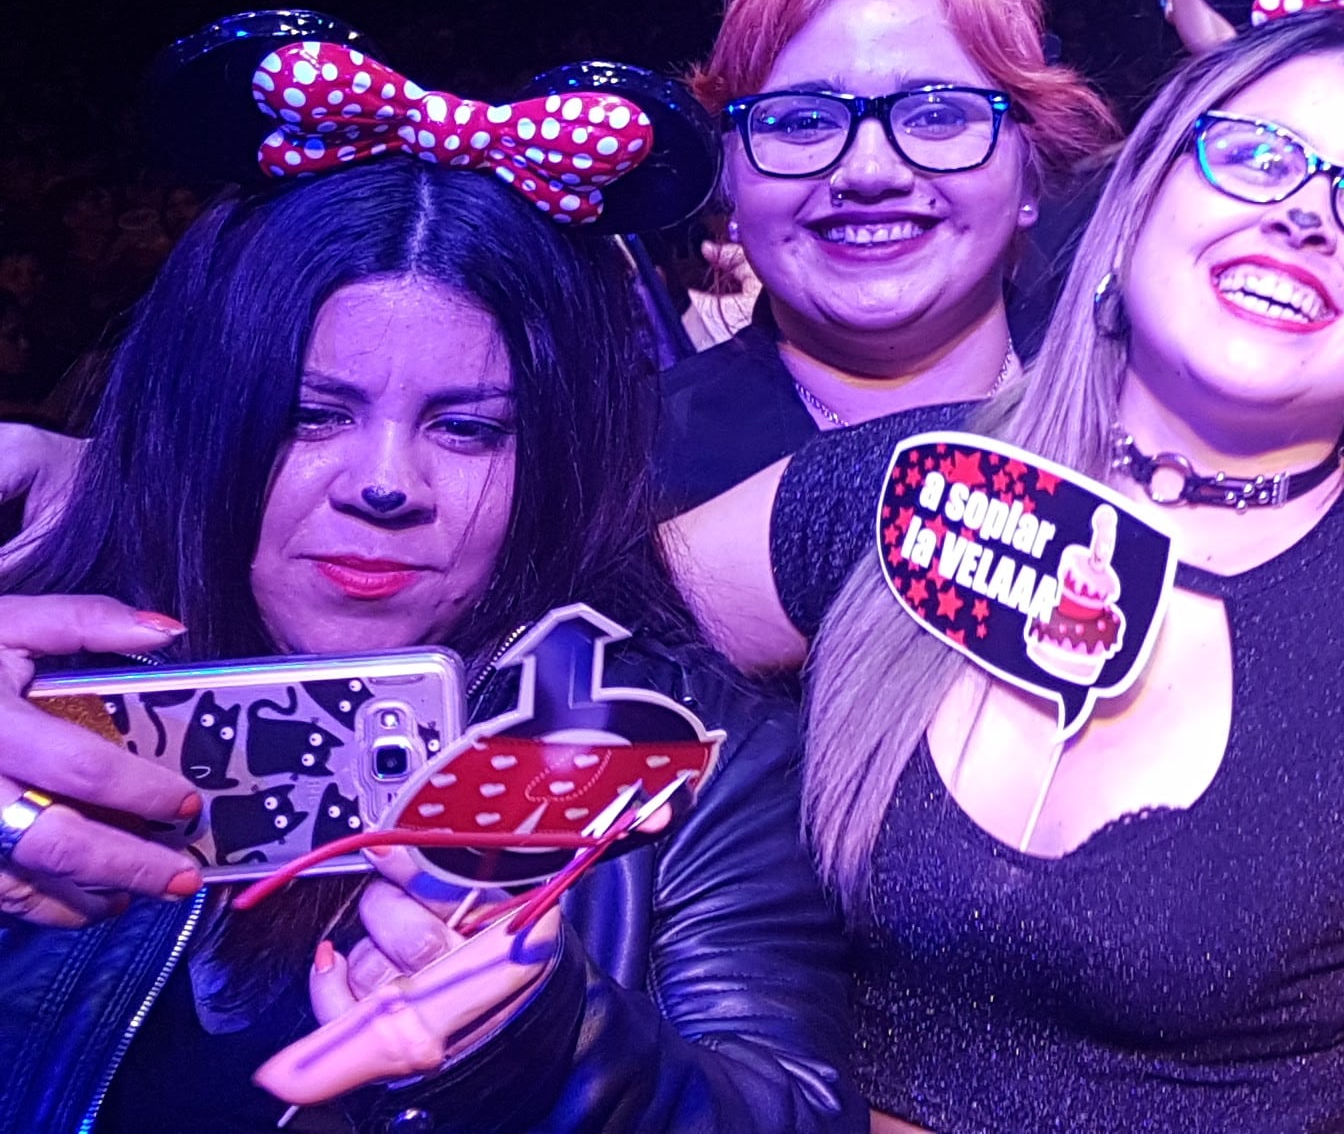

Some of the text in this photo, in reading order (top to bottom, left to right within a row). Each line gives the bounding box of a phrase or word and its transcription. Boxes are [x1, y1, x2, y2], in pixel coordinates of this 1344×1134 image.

[920, 471, 1056, 559] a soplar
[900, 515, 1058, 624] la VELAAA
